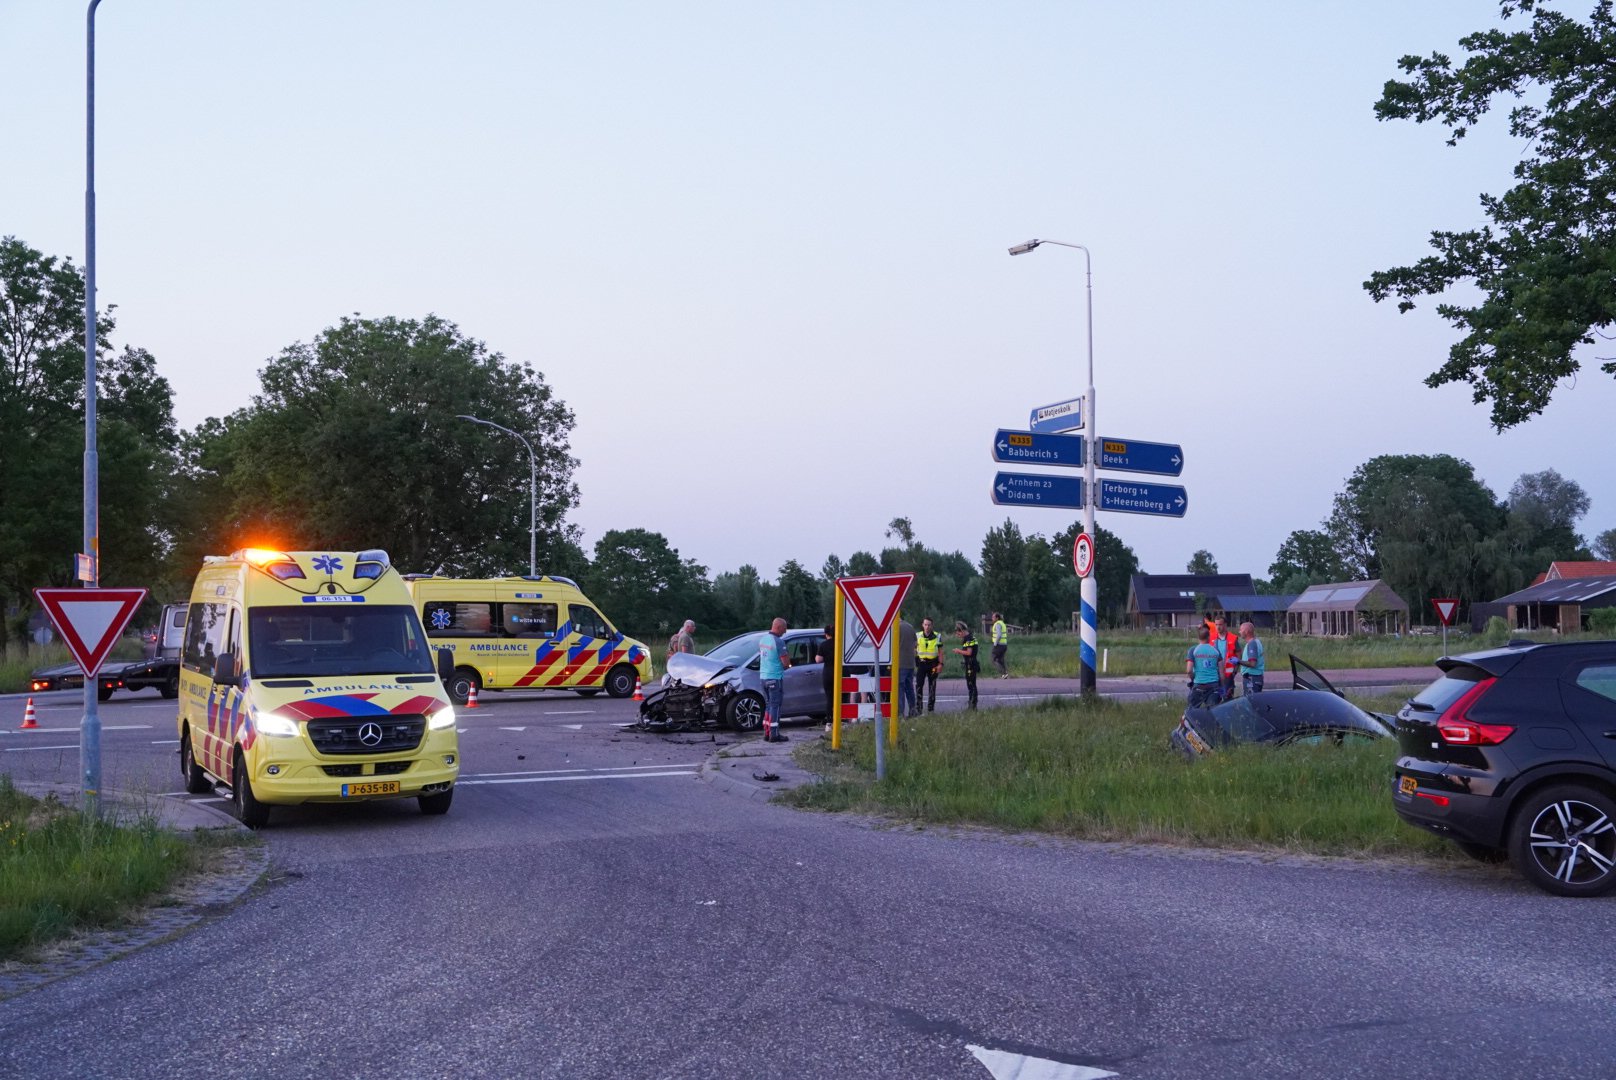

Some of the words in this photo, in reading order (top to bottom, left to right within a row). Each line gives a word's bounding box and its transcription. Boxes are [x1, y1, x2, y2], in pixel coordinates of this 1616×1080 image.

[1044, 403, 1071, 417] Matjeskolk
[1010, 435, 1031, 445] N335
[1008, 447, 1051, 459] Babberich
[1105, 443, 1125, 453] N335
[1103, 454, 1123, 464] Beek
[1008, 478, 1041, 488] Arnhem
[1008, 490, 1034, 500] Didam
[1103, 483, 1137, 497] Terborg
[1139, 488, 1148, 496] 14
[1103, 496, 1164, 511] 's-Heerenberg
[304, 684, 415, 694] AMBULANCE
[351, 783, 395, 794] J-635-BR
